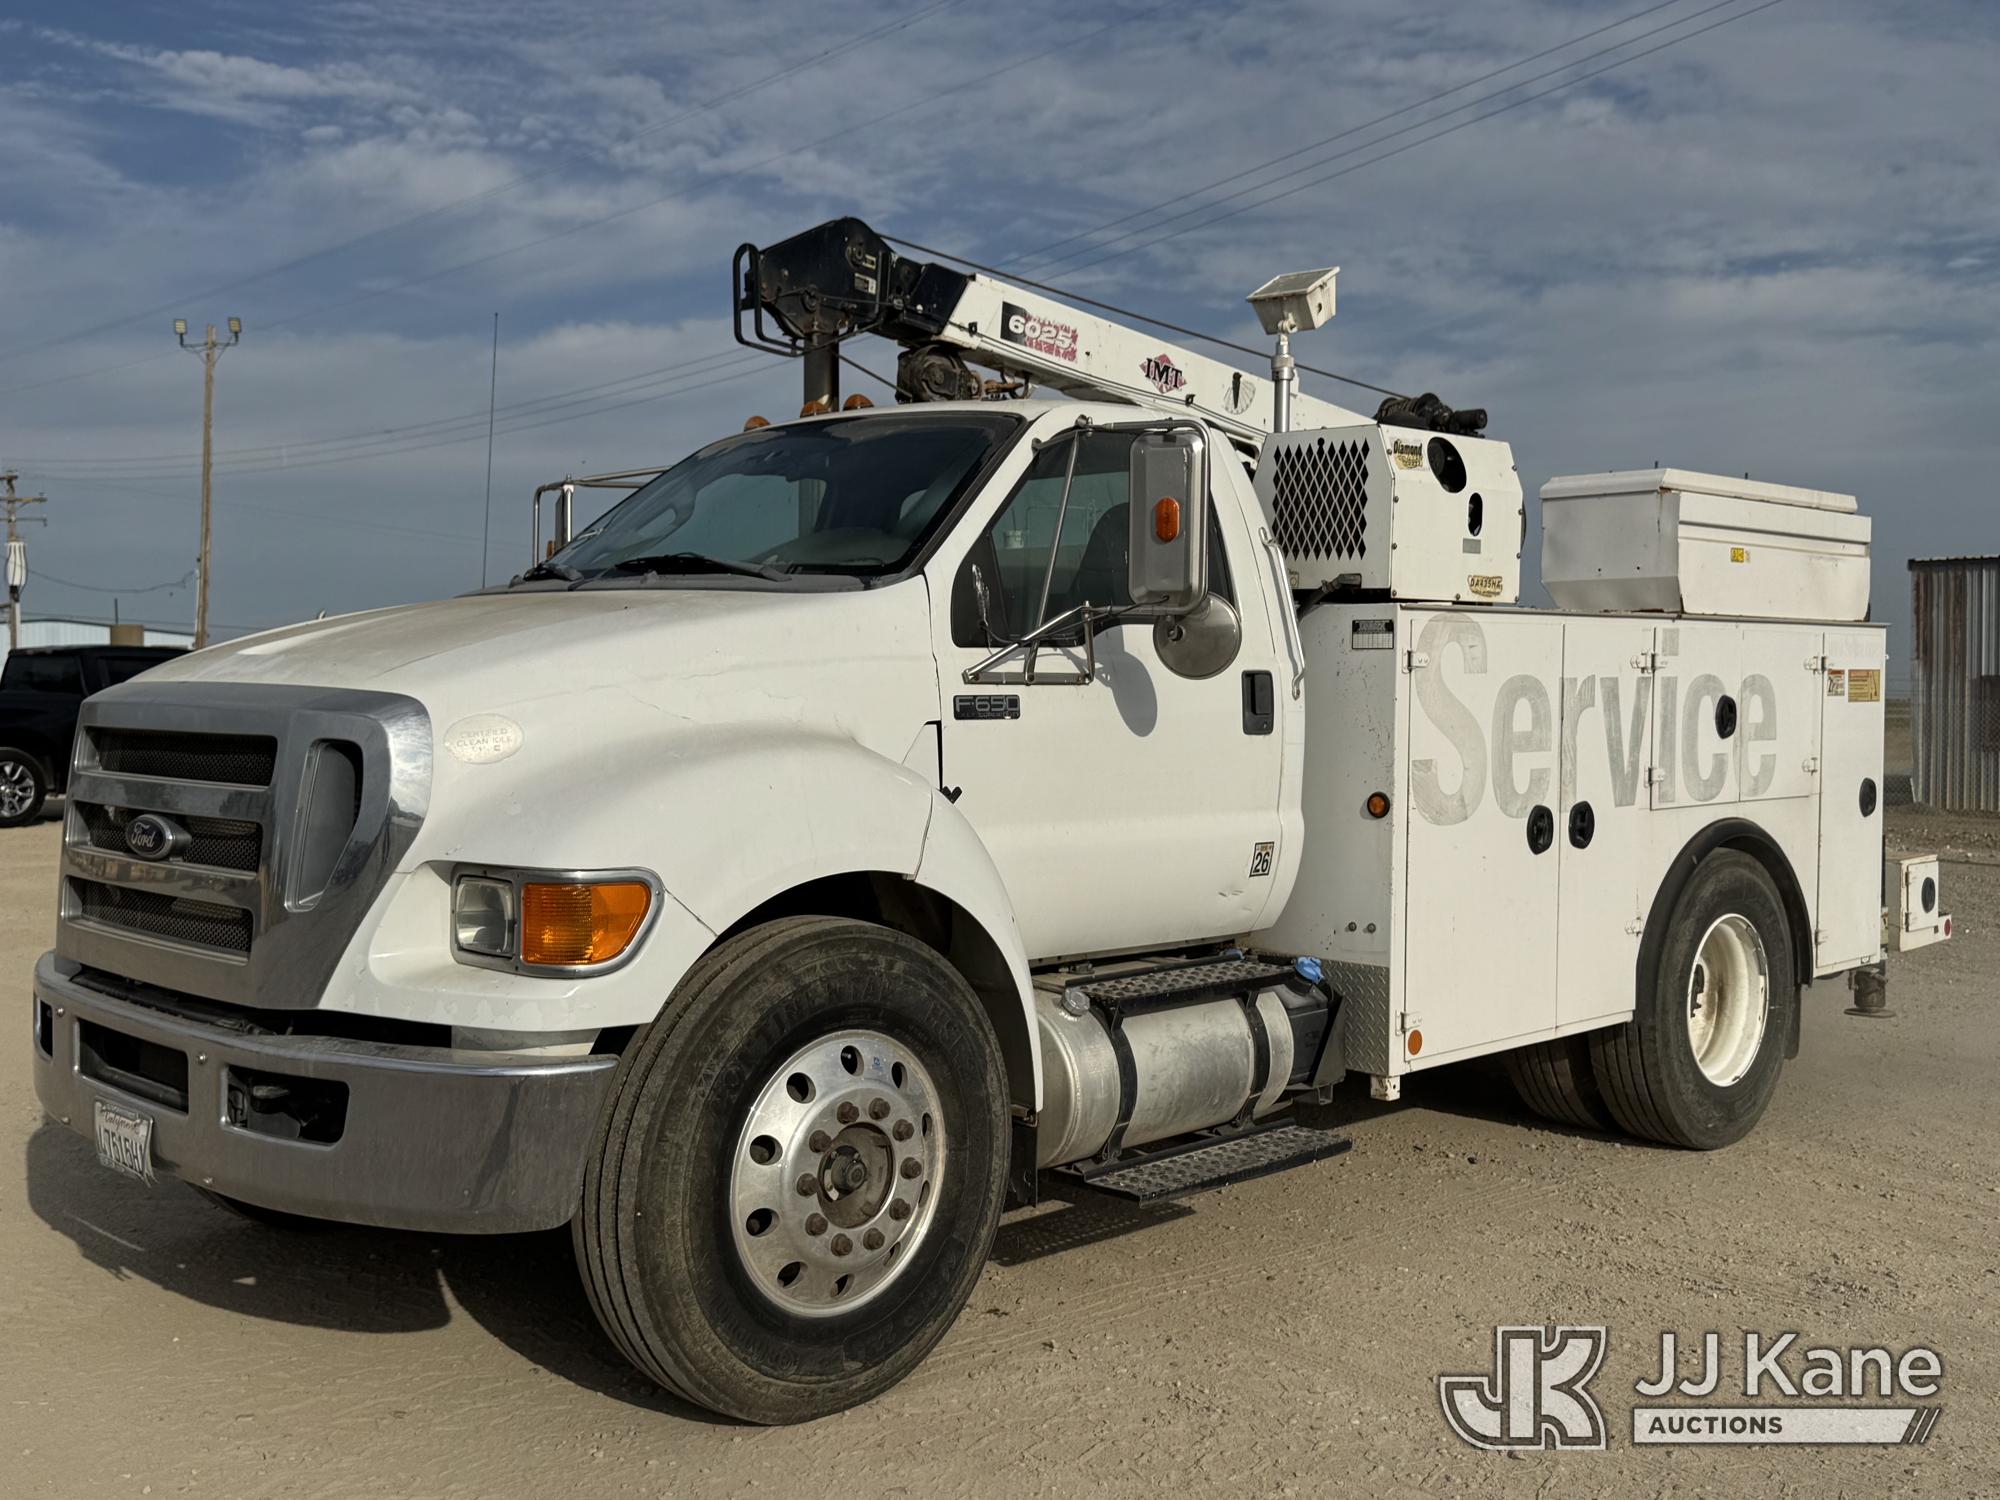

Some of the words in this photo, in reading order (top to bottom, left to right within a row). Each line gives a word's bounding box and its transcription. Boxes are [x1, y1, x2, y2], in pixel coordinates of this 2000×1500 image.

[1008, 314, 1073, 350] 6025
[1145, 357, 1182, 389] IMT
[1393, 439, 1422, 456] Diamond
[955, 696, 1019, 712] F-650
[1412, 612, 1777, 826] Service
[131, 822, 152, 848] Ford
[1252, 851, 1270, 873] 26
